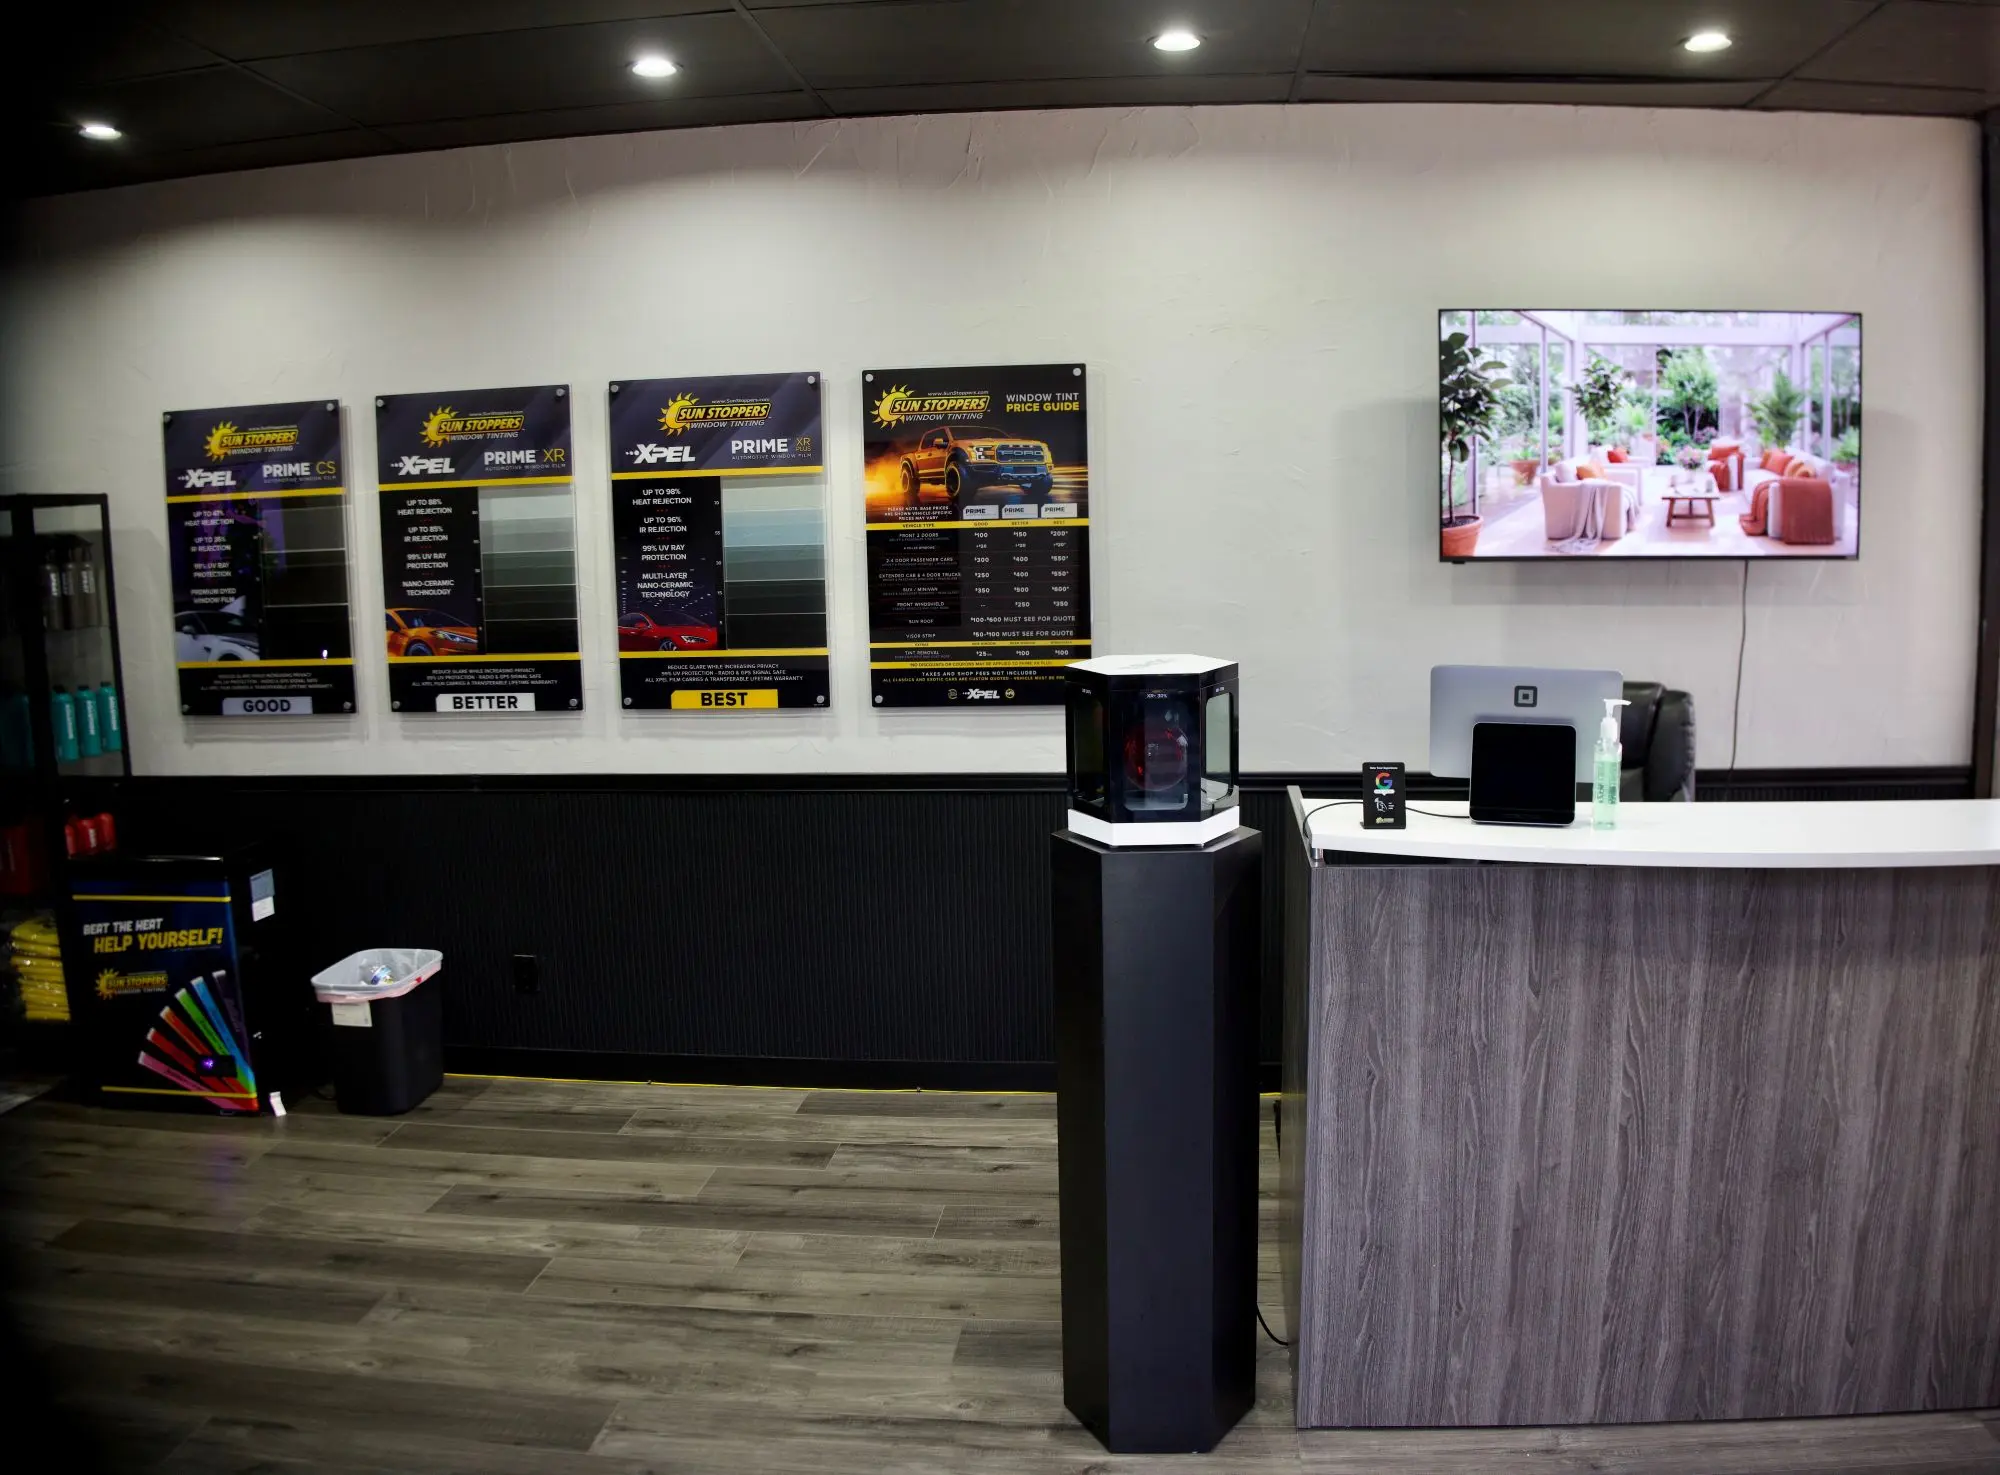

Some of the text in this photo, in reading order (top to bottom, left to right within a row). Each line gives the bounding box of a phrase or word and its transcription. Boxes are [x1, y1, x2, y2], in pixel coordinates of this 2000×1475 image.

[1006, 392, 1080, 402] WINDOW TINT
[678, 404, 768, 420] SUN STOPPERS
[892, 398, 987, 412] SUN STOPPERS
[1006, 402, 1080, 412] PRICE GUIDE
[906, 412, 984, 422] WINDOW TINTING
[439, 417, 522, 432] SUN STOPPERS
[690, 420, 765, 429] WINDOW TINTING
[222, 431, 297, 447] SUN STOPPERS
[450, 433, 484, 442] WINDOW
[731, 438, 811, 454] PRIME XR
[484, 448, 566, 466] PRIME XR
[634, 444, 696, 464] XPEL
[262, 461, 337, 478] PRIME CS
[398, 455, 456, 476] XPEL
[184, 468, 237, 489] XPEL
[632, 498, 652, 506] HEAT
[648, 526, 687, 534] REJECTION
[433, 552, 447, 560] RAY
[642, 572, 688, 580] MULTI-LAYER
[402, 580, 454, 588] NANO-CERAMIC
[701, 692, 748, 706] BEST
[967, 688, 1000, 700] XPEL
[243, 699, 291, 713] GOOD
[453, 696, 519, 710] BETTER
[83, 918, 164, 936] BEAT THE HEAT
[94, 934, 133, 954] HELP
[137, 928, 224, 950] YOURSELF!
[127, 976, 166, 988] STOPPERS
